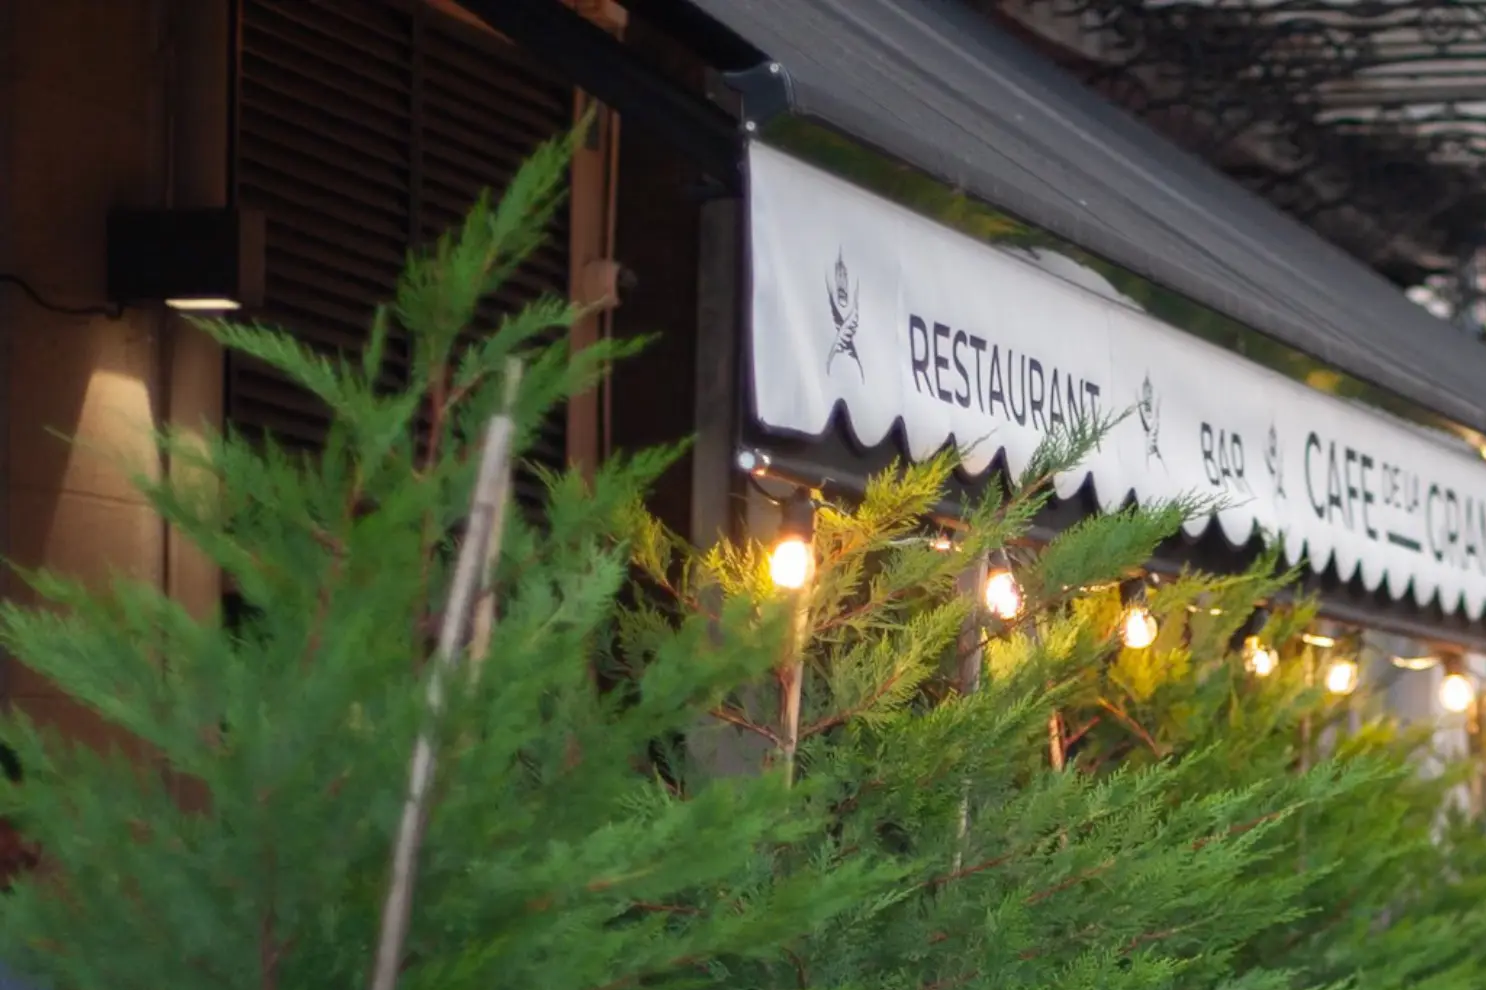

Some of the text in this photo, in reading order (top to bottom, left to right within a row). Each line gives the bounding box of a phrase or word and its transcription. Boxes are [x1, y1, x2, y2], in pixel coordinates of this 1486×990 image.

[909, 313, 1101, 453] RESTAURANT
[1201, 421, 1256, 499] BAR
[1304, 431, 1378, 541] CAFE
